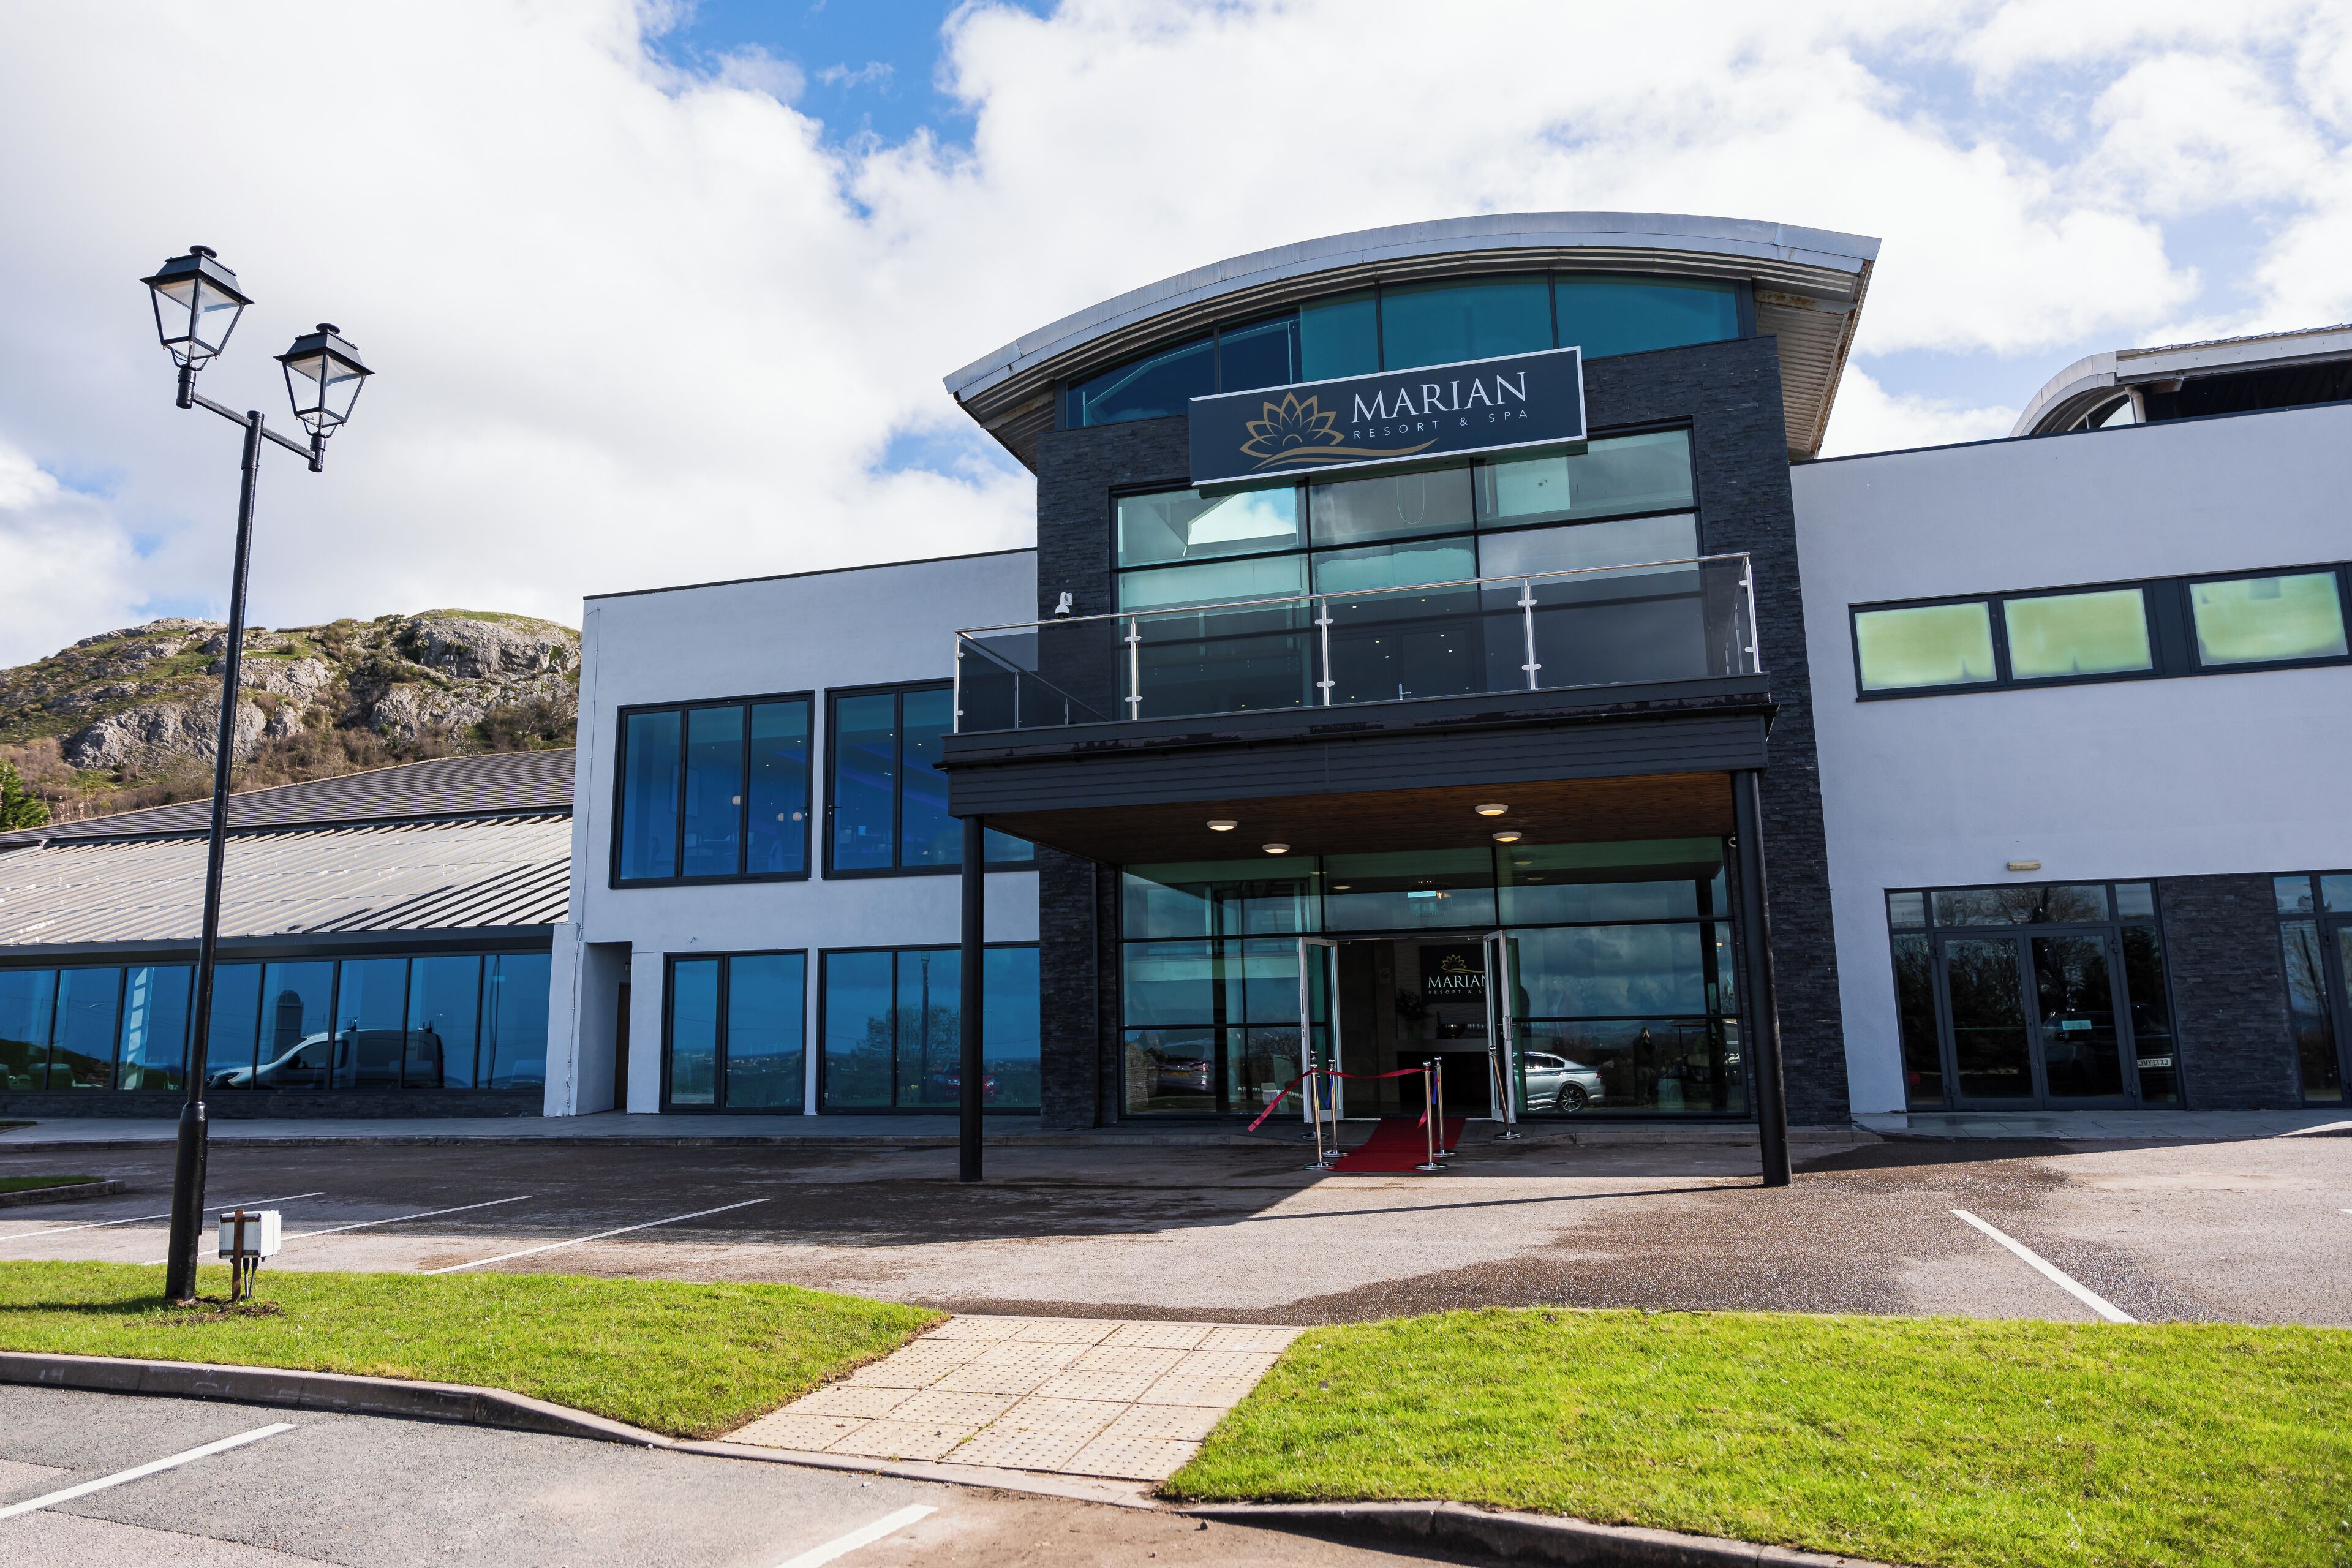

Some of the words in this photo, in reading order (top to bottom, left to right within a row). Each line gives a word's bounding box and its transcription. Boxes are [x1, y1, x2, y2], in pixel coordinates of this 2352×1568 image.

[1351, 371, 1527, 423] MARIAN
[1354, 420, 1439, 439] RESORT
[1460, 417, 1468, 426] &
[1489, 410, 1527, 423] SPA
